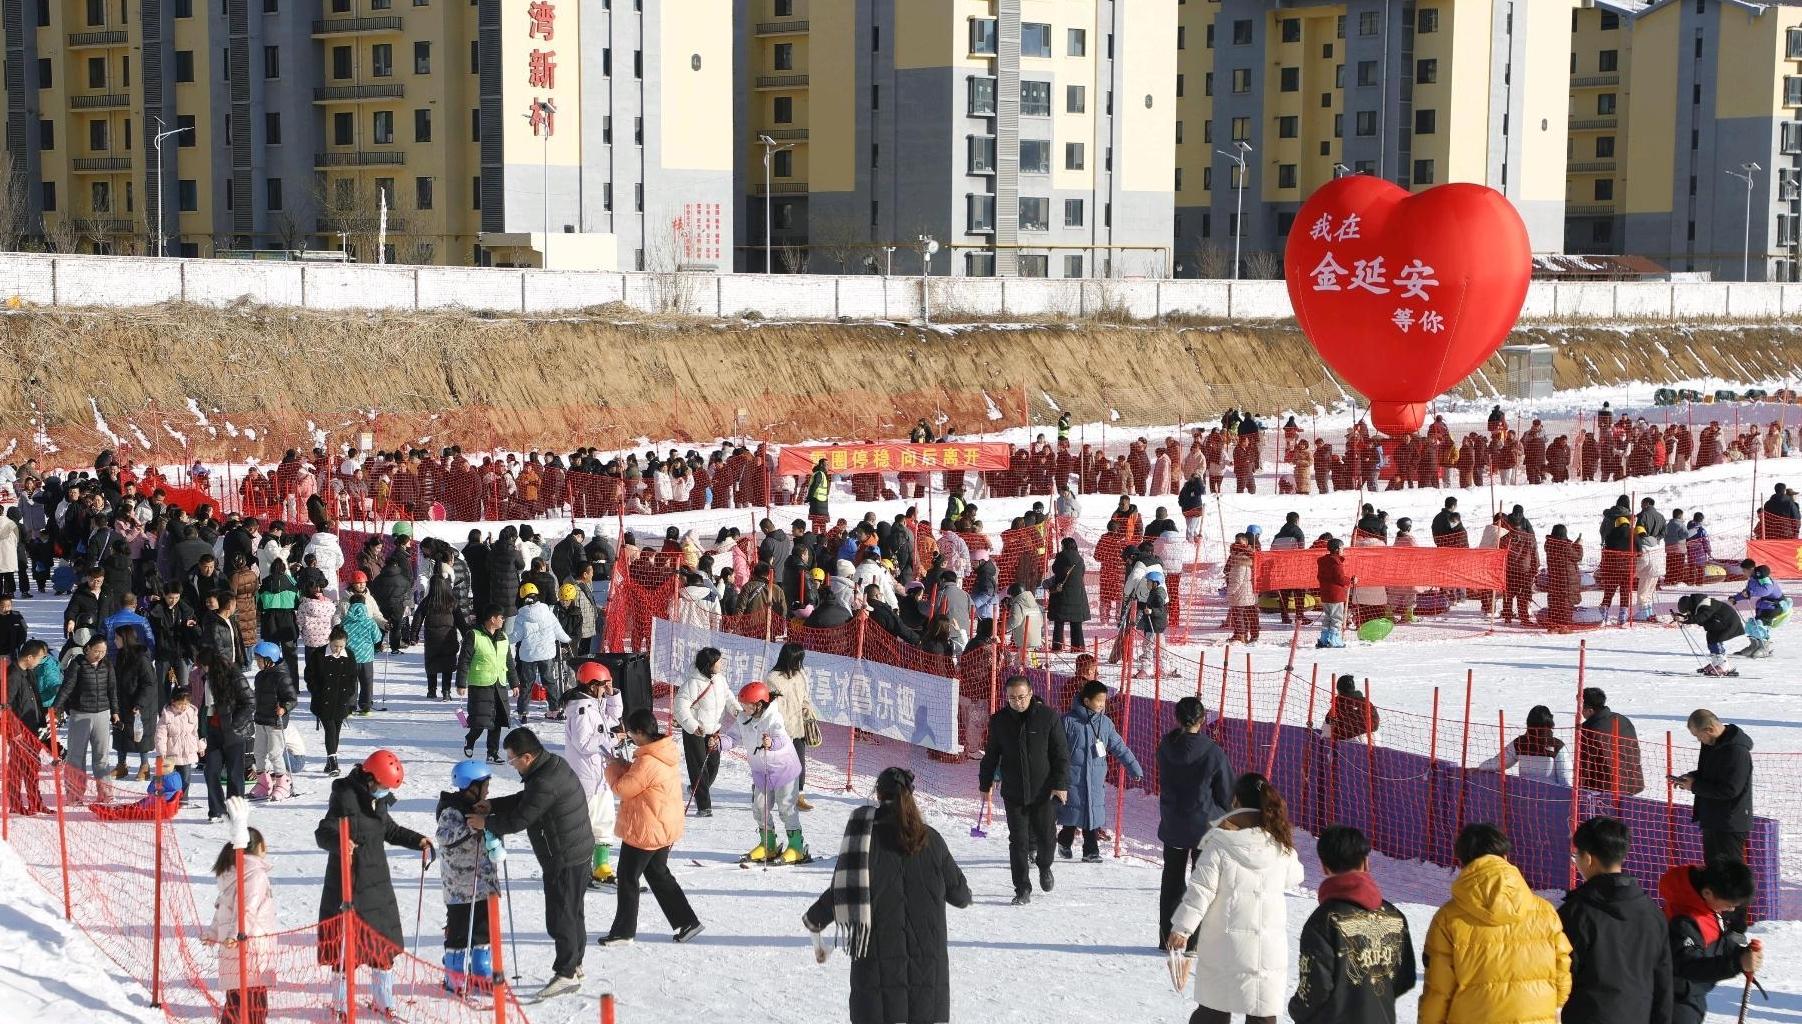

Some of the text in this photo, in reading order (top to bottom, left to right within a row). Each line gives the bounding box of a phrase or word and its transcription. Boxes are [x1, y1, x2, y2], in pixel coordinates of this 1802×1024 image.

[1310, 212, 1361, 242] 我在
[1310, 251, 1440, 301] 金延安
[1391, 308, 1445, 334] 等你
[901, 447, 980, 467] 向后离开
[805, 665, 916, 727] 享冰雪乐趣
